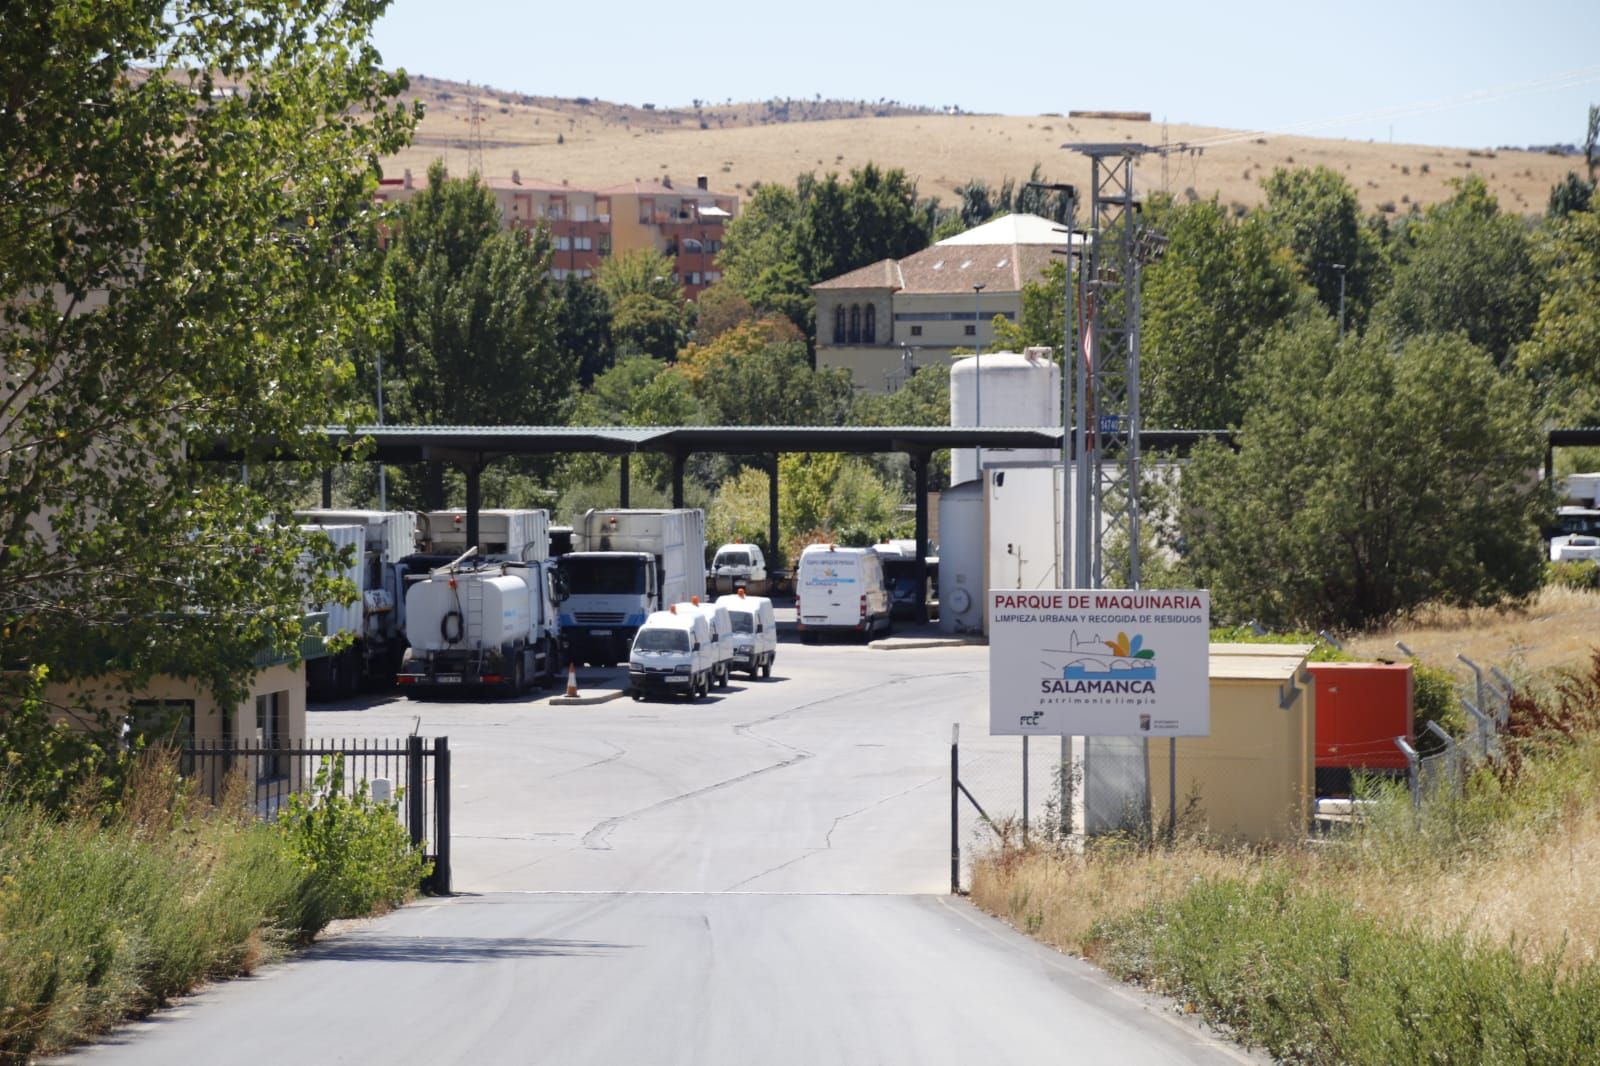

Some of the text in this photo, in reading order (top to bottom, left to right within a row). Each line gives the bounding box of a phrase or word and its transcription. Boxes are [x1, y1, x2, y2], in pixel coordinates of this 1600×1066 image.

[995, 595, 1202, 609] PARQUE DE MAQUINARIA
[995, 614, 1202, 623] LIMPIEZA URBANA Y RECOGIDA DE RESIDUOS
[1041, 680, 1155, 694] SALAMANCA
[1040, 697, 1156, 706] patrimonio limpio
[1020, 715, 1040, 725] FCC
